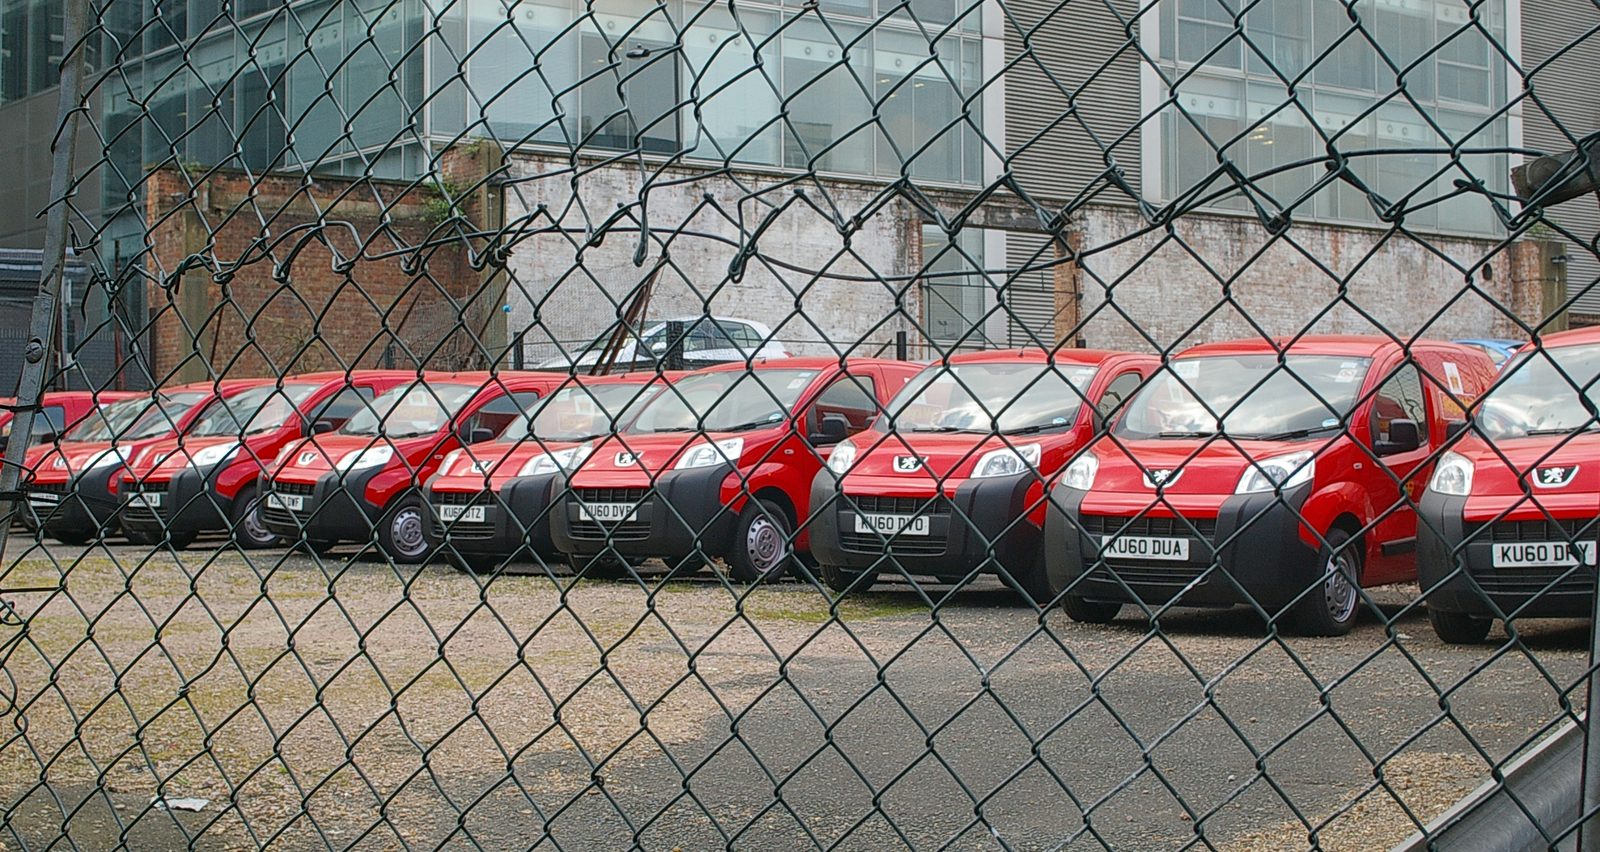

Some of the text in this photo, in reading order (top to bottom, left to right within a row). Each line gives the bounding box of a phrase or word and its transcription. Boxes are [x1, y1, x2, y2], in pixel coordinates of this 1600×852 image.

[584, 504, 609, 517] KU60
[861, 515, 923, 531] KU60 DVO
[1109, 538, 1181, 556] KU60 DUA
[1501, 545, 1547, 562] KU60
